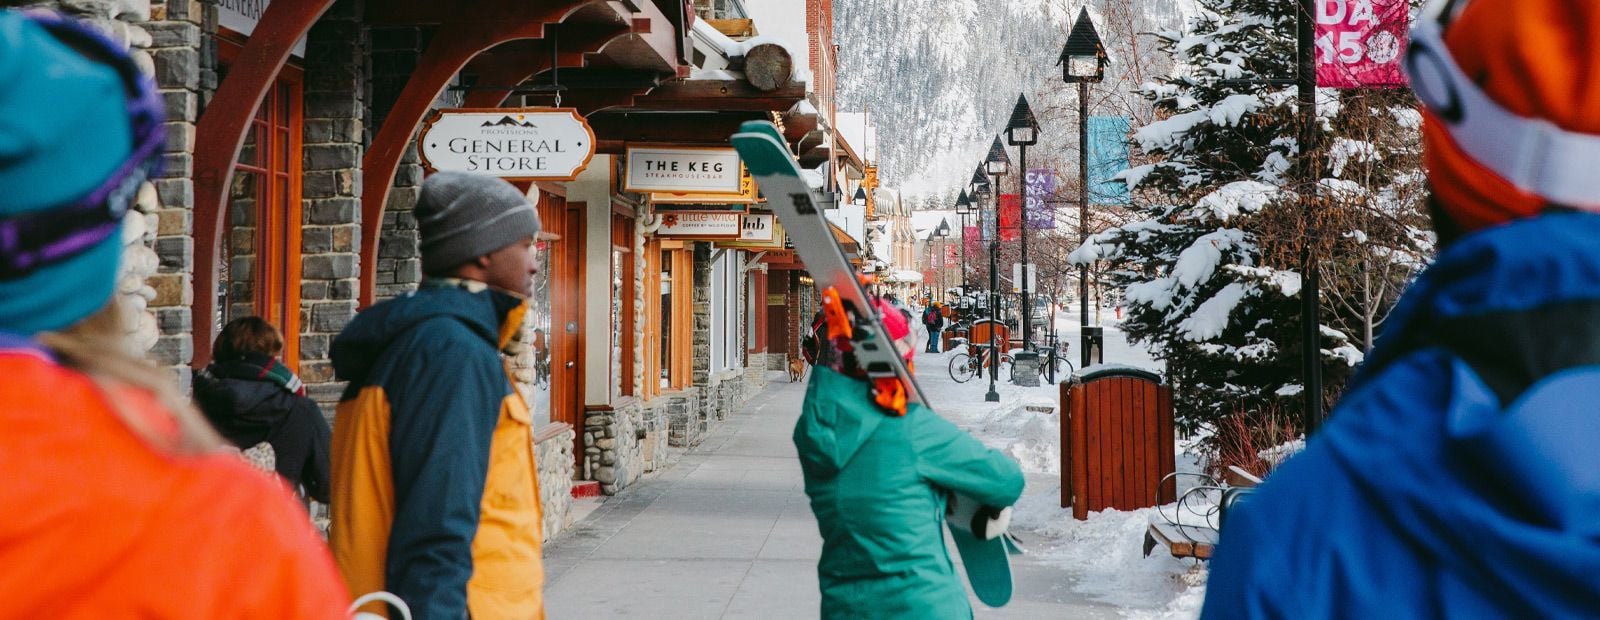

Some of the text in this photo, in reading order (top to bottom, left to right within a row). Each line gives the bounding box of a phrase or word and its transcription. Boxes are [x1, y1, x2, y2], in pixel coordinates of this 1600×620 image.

[448, 138, 565, 153] GENERAL
[467, 155, 546, 171] STORE
[645, 160, 723, 172] THE KEG
[1025, 172, 1046, 184] CA
